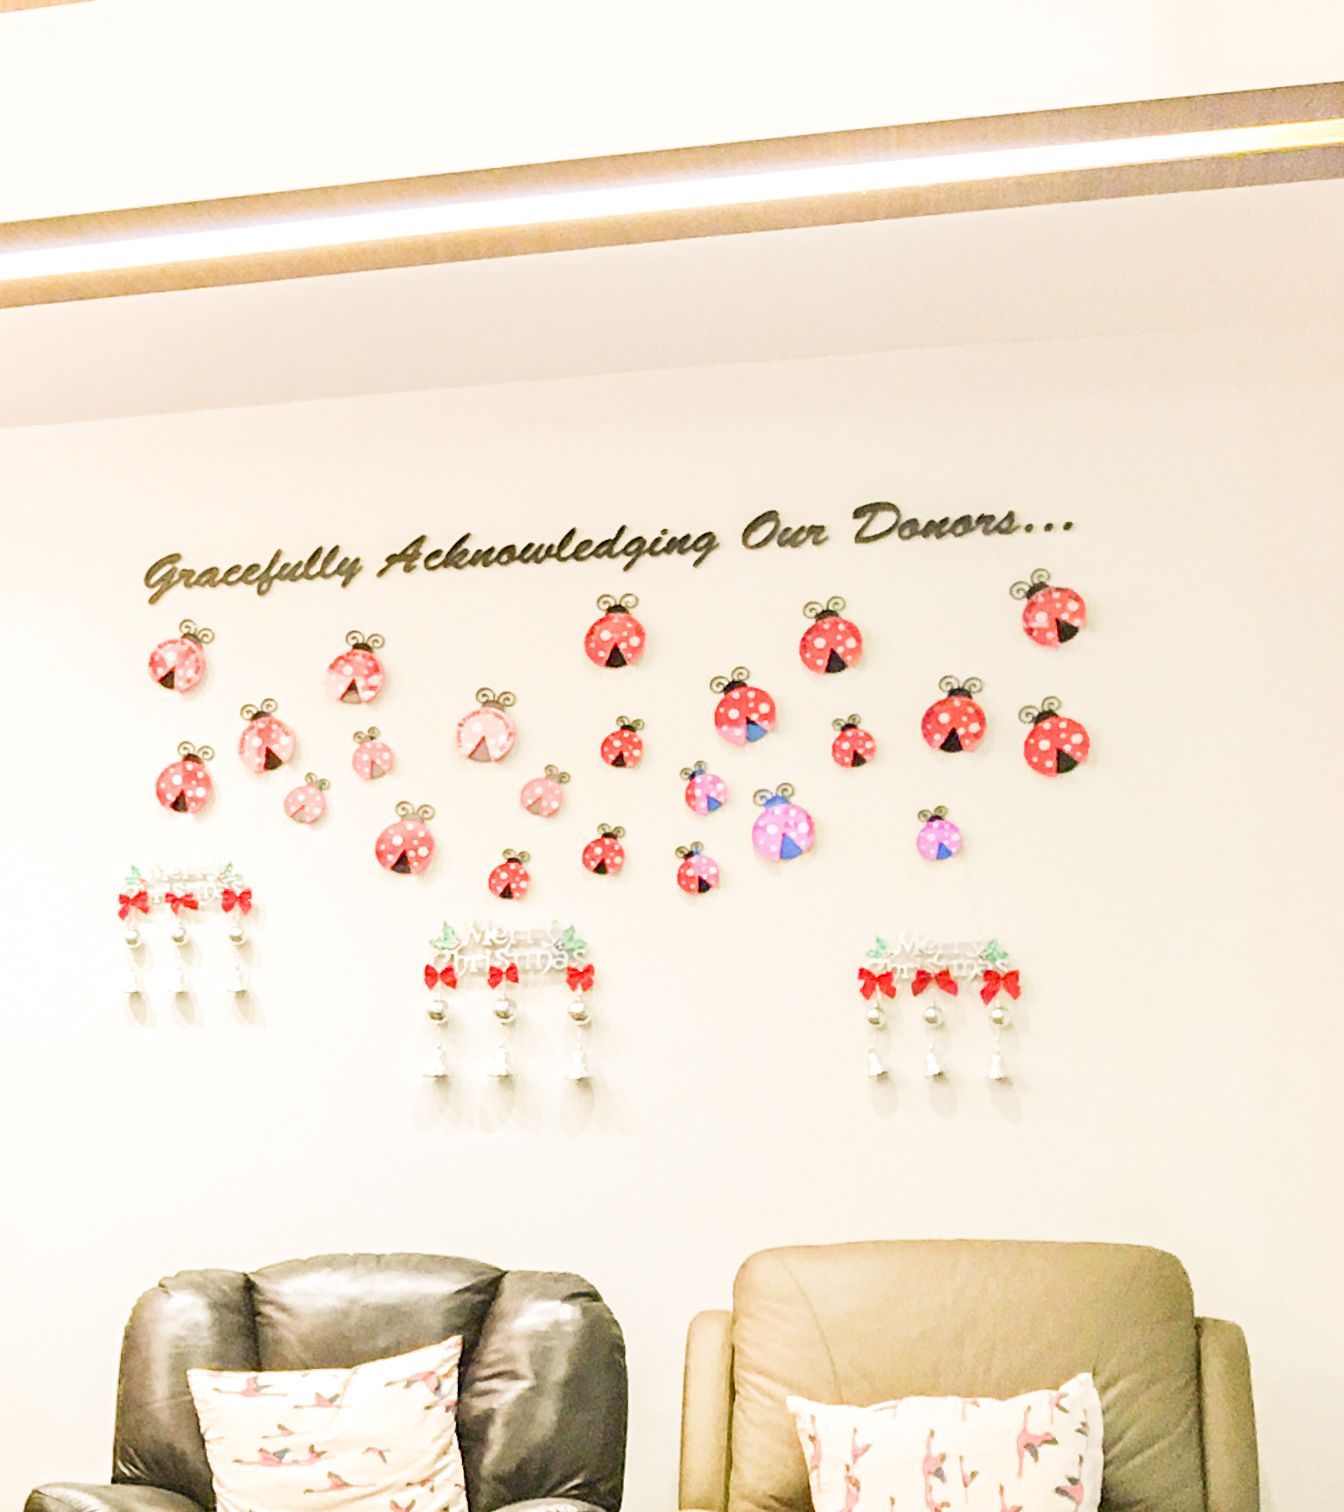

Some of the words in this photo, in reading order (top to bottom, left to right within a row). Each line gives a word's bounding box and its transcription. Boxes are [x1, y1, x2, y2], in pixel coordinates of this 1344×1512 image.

[144, 544, 363, 605] Gracefully
[376, 525, 720, 578] Acknowledging
[741, 510, 830, 550] Our
